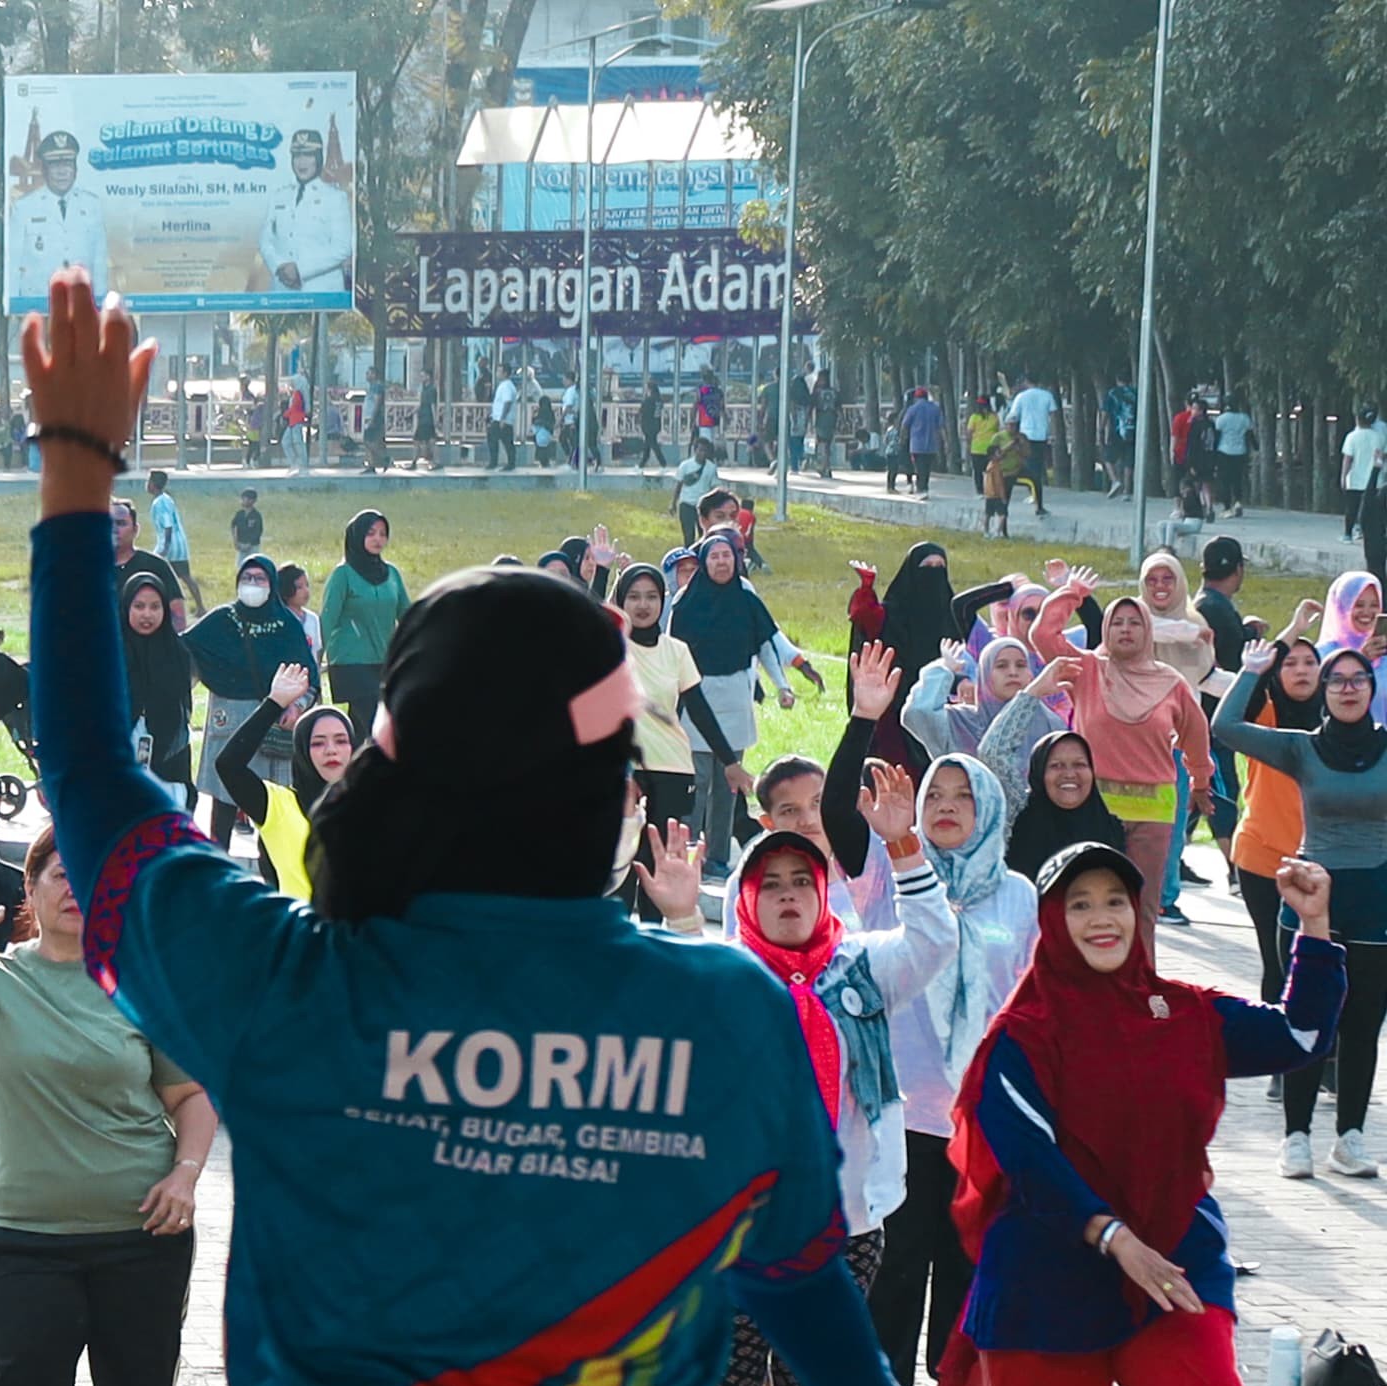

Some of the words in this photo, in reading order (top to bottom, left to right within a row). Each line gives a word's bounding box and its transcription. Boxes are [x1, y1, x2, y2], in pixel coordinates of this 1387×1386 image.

[101, 117, 181, 141] Selamat
[186, 117, 258, 140] Datang
[106, 184, 147, 198] Wesly
[162, 220, 211, 232] Herlina
[419, 255, 641, 329] Lapangan
[658, 249, 790, 313] Adam
[382, 1029, 693, 1117] KORMI
[460, 1116, 568, 1151] BUGAR,
[576, 1123, 708, 1161] GEMBIRA
[433, 1141, 514, 1175] LUAR
[519, 1151, 620, 1185] BIASA!
